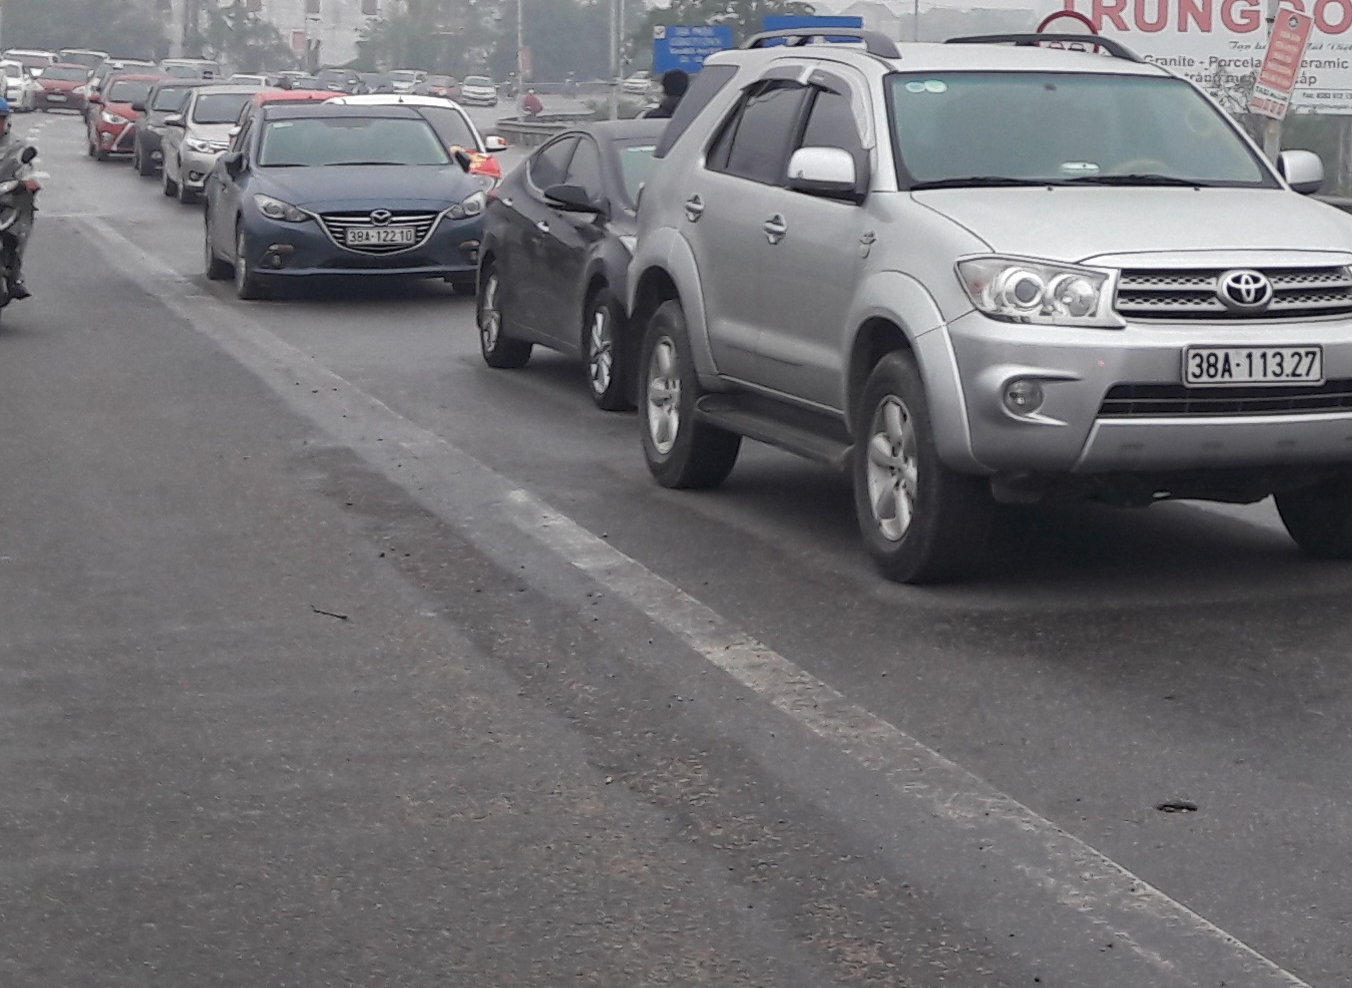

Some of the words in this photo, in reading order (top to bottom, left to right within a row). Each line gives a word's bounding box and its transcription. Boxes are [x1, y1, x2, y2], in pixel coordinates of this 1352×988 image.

[1208, 56, 1264, 68] Porcela
[1300, 58, 1350, 69] eramic
[1190, 350, 1318, 379] 38A-113.27
